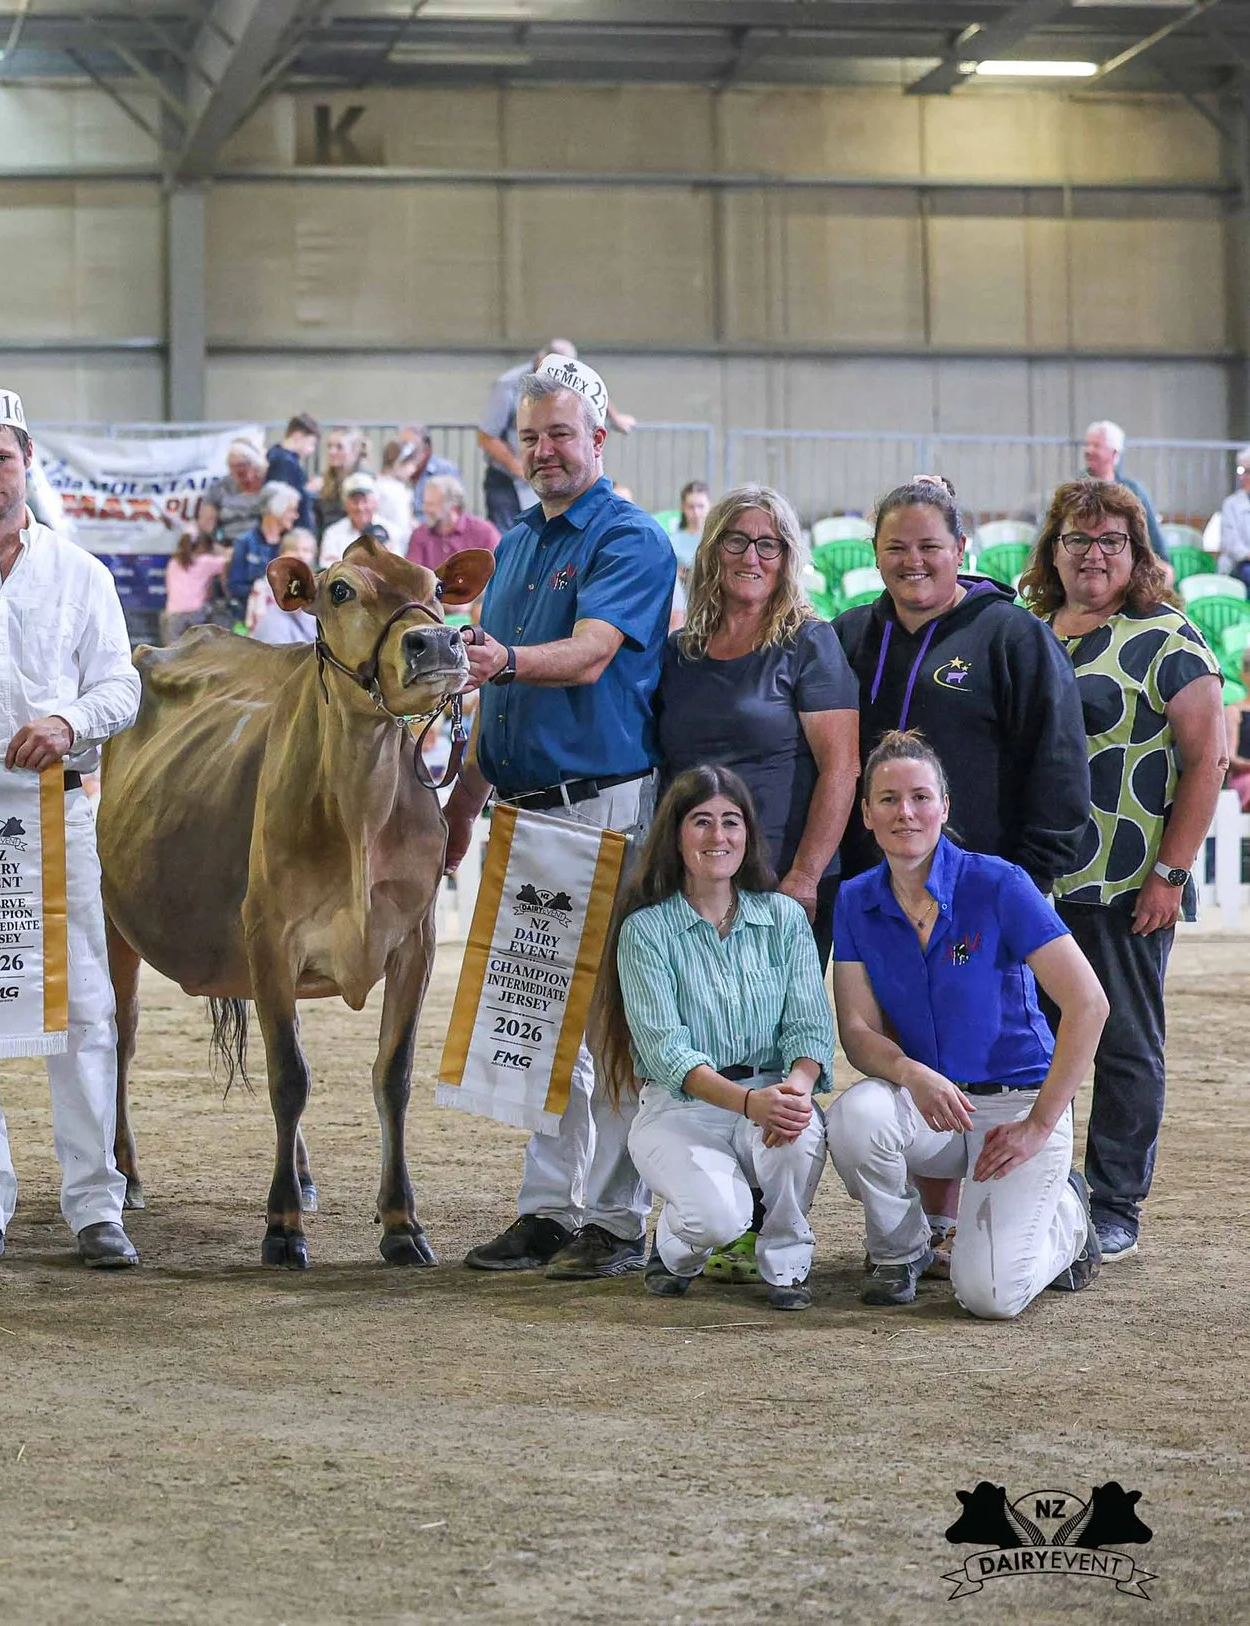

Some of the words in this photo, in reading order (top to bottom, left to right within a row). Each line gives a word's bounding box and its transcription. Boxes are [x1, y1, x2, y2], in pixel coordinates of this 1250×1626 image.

[314, 104, 366, 163] K
[547, 366, 589, 394] SEMEX
[2, 395, 23, 423] 16
[514, 927, 561, 947] DAIRY
[530, 917, 550, 931] NZ
[510, 940, 559, 960] EVENT
[490, 959, 570, 988] CHAMPION
[487, 973, 566, 1002] INTERMEDIATE
[498, 990, 552, 1012] JERSEY
[493, 1016, 543, 1042] 2026
[493, 1049, 533, 1069] FMG
